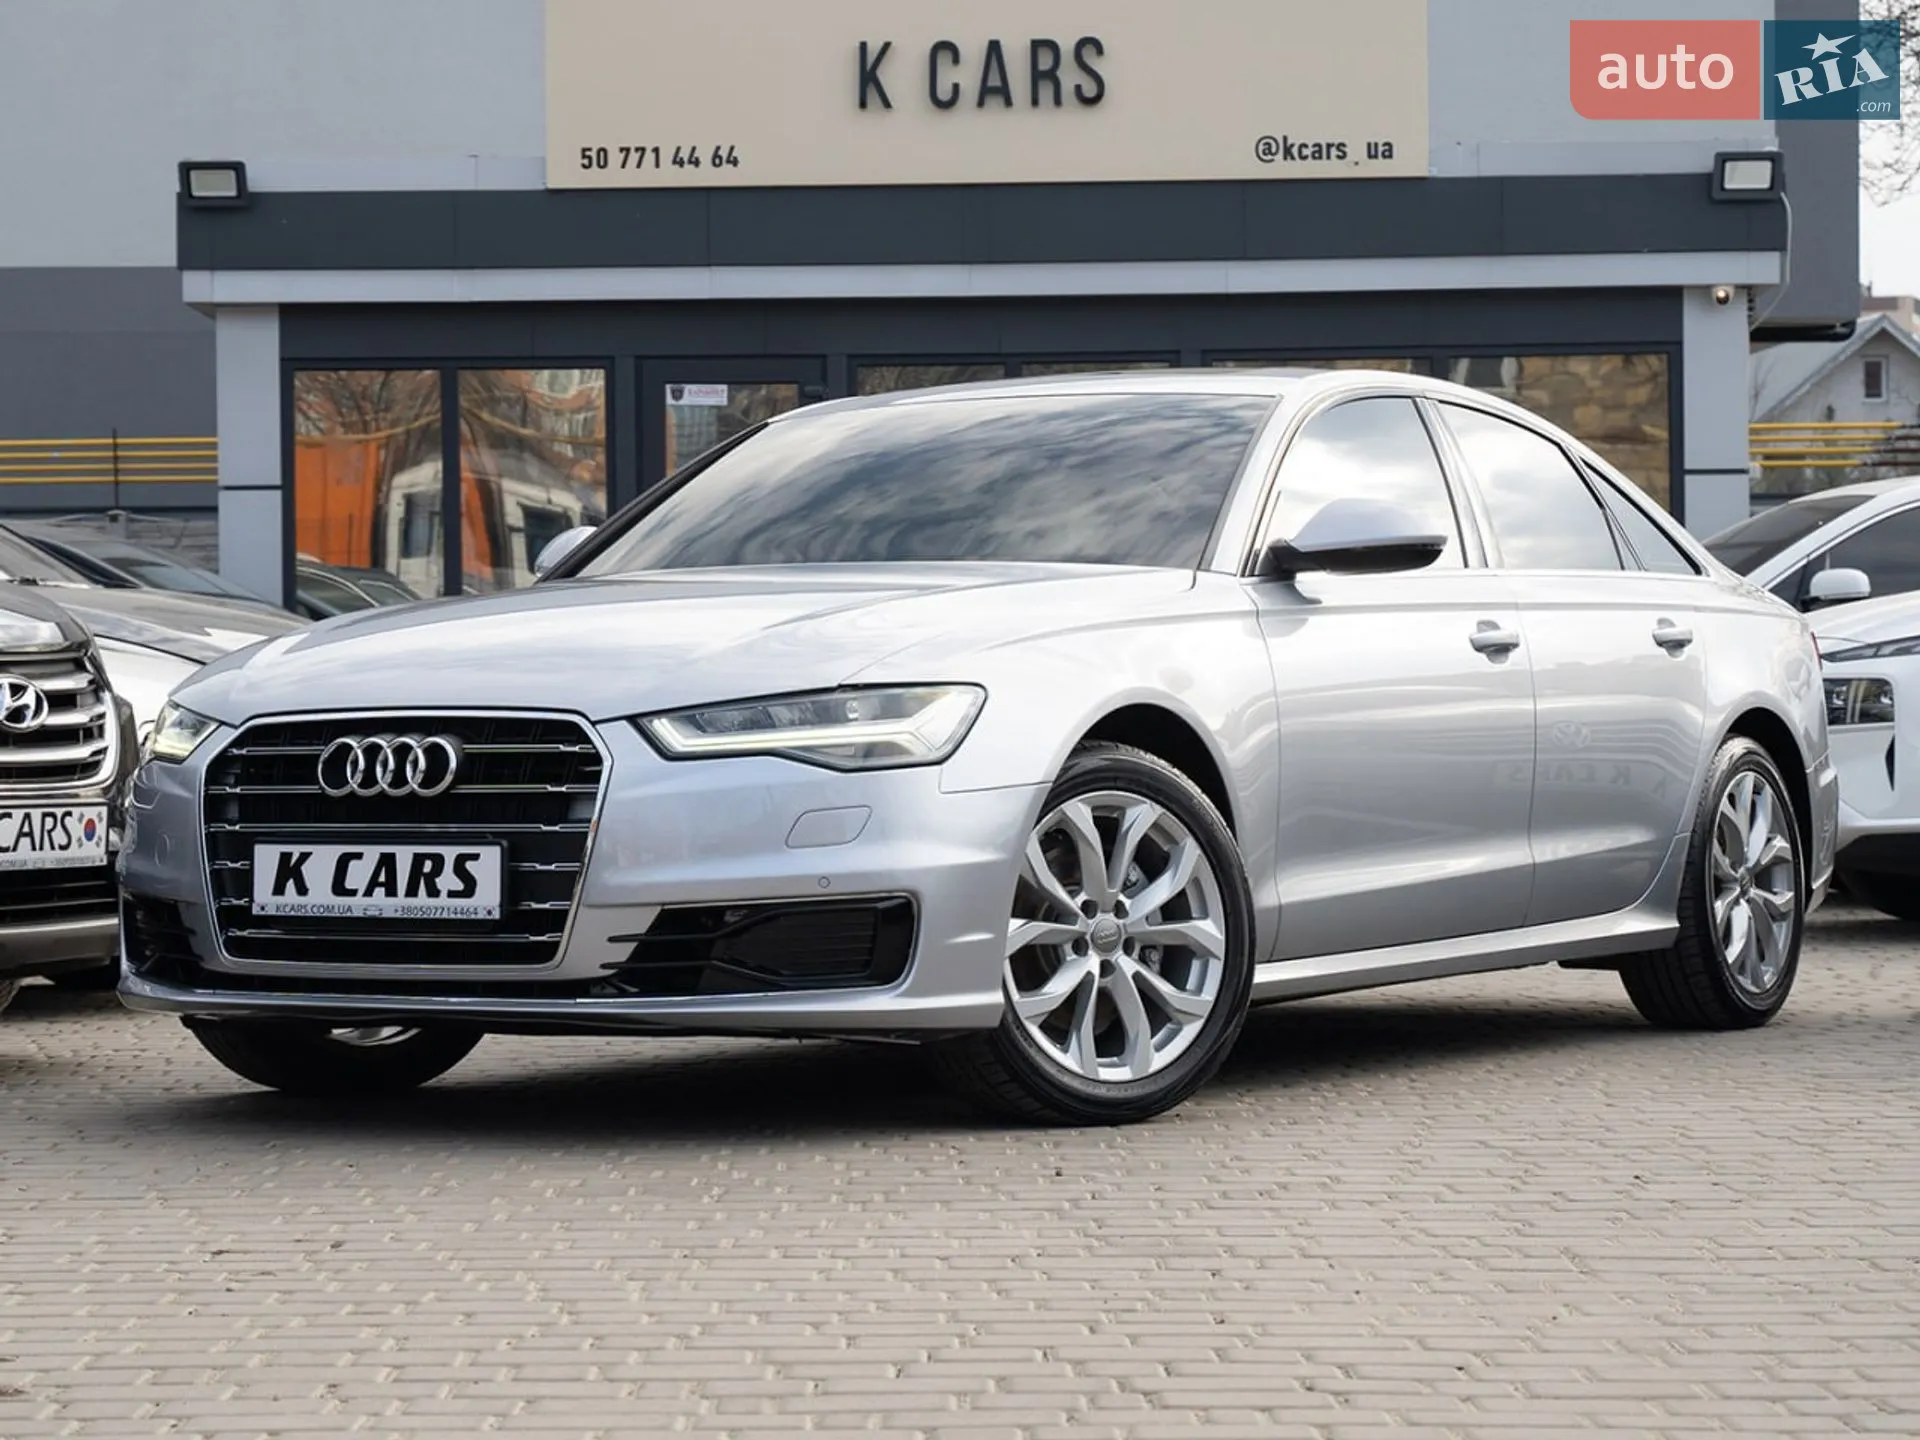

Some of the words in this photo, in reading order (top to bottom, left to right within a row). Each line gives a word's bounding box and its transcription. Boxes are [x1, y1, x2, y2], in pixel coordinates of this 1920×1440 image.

[857, 40, 894, 111] K
[927, 36, 1106, 112] CARS
[580, 147, 609, 170] 50
[619, 146, 661, 170] 771
[671, 145, 702, 169] 44
[711, 144, 740, 168] 64
[271, 851, 313, 897] K
[331, 851, 482, 899] CARS
[275, 903, 353, 915] KCARS.COM.UA
